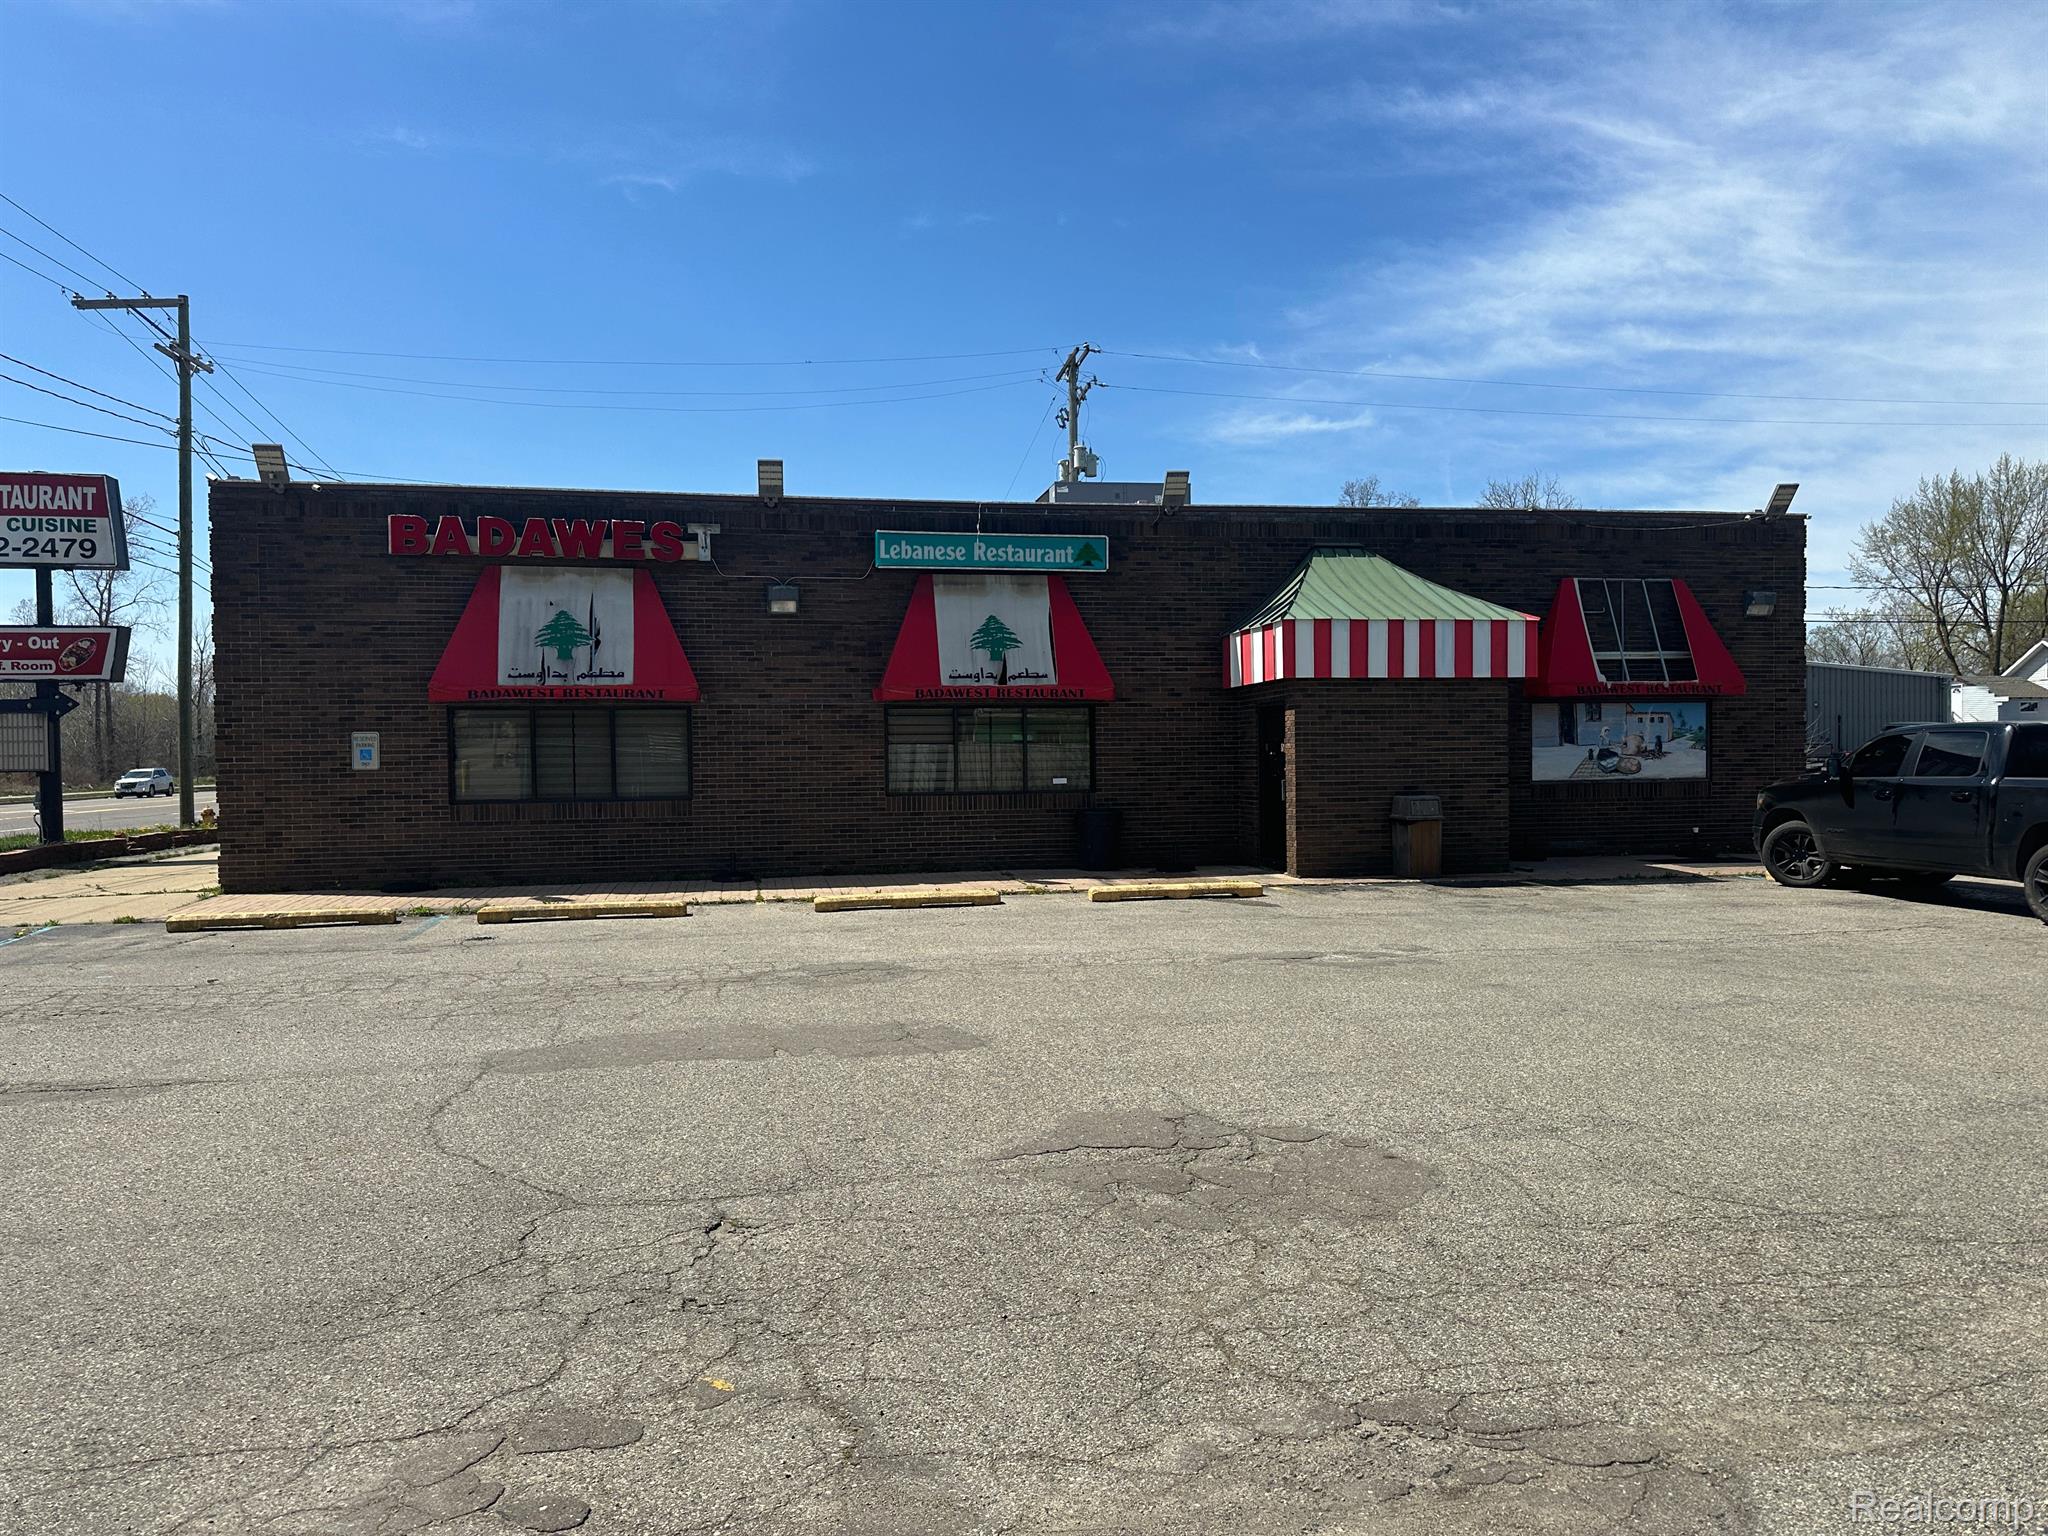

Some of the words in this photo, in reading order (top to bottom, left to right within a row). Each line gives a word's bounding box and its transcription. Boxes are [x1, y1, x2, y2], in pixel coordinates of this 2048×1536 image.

[6, 517, 97, 533] CUISINE
[387, 513, 721, 562] BADAWEST
[879, 539, 966, 562] Lebanese
[973, 541, 1075, 563] Restaurant
[27, 636, 60, 649] Out
[10, 661, 53, 671] Room
[467, 689, 556, 699] BADAWEST
[562, 688, 666, 699] RESTAURANT
[914, 688, 991, 699] BADAWEST
[996, 688, 1086, 698] RESTAURANT
[1646, 683, 1723, 695] RESTAURANT
